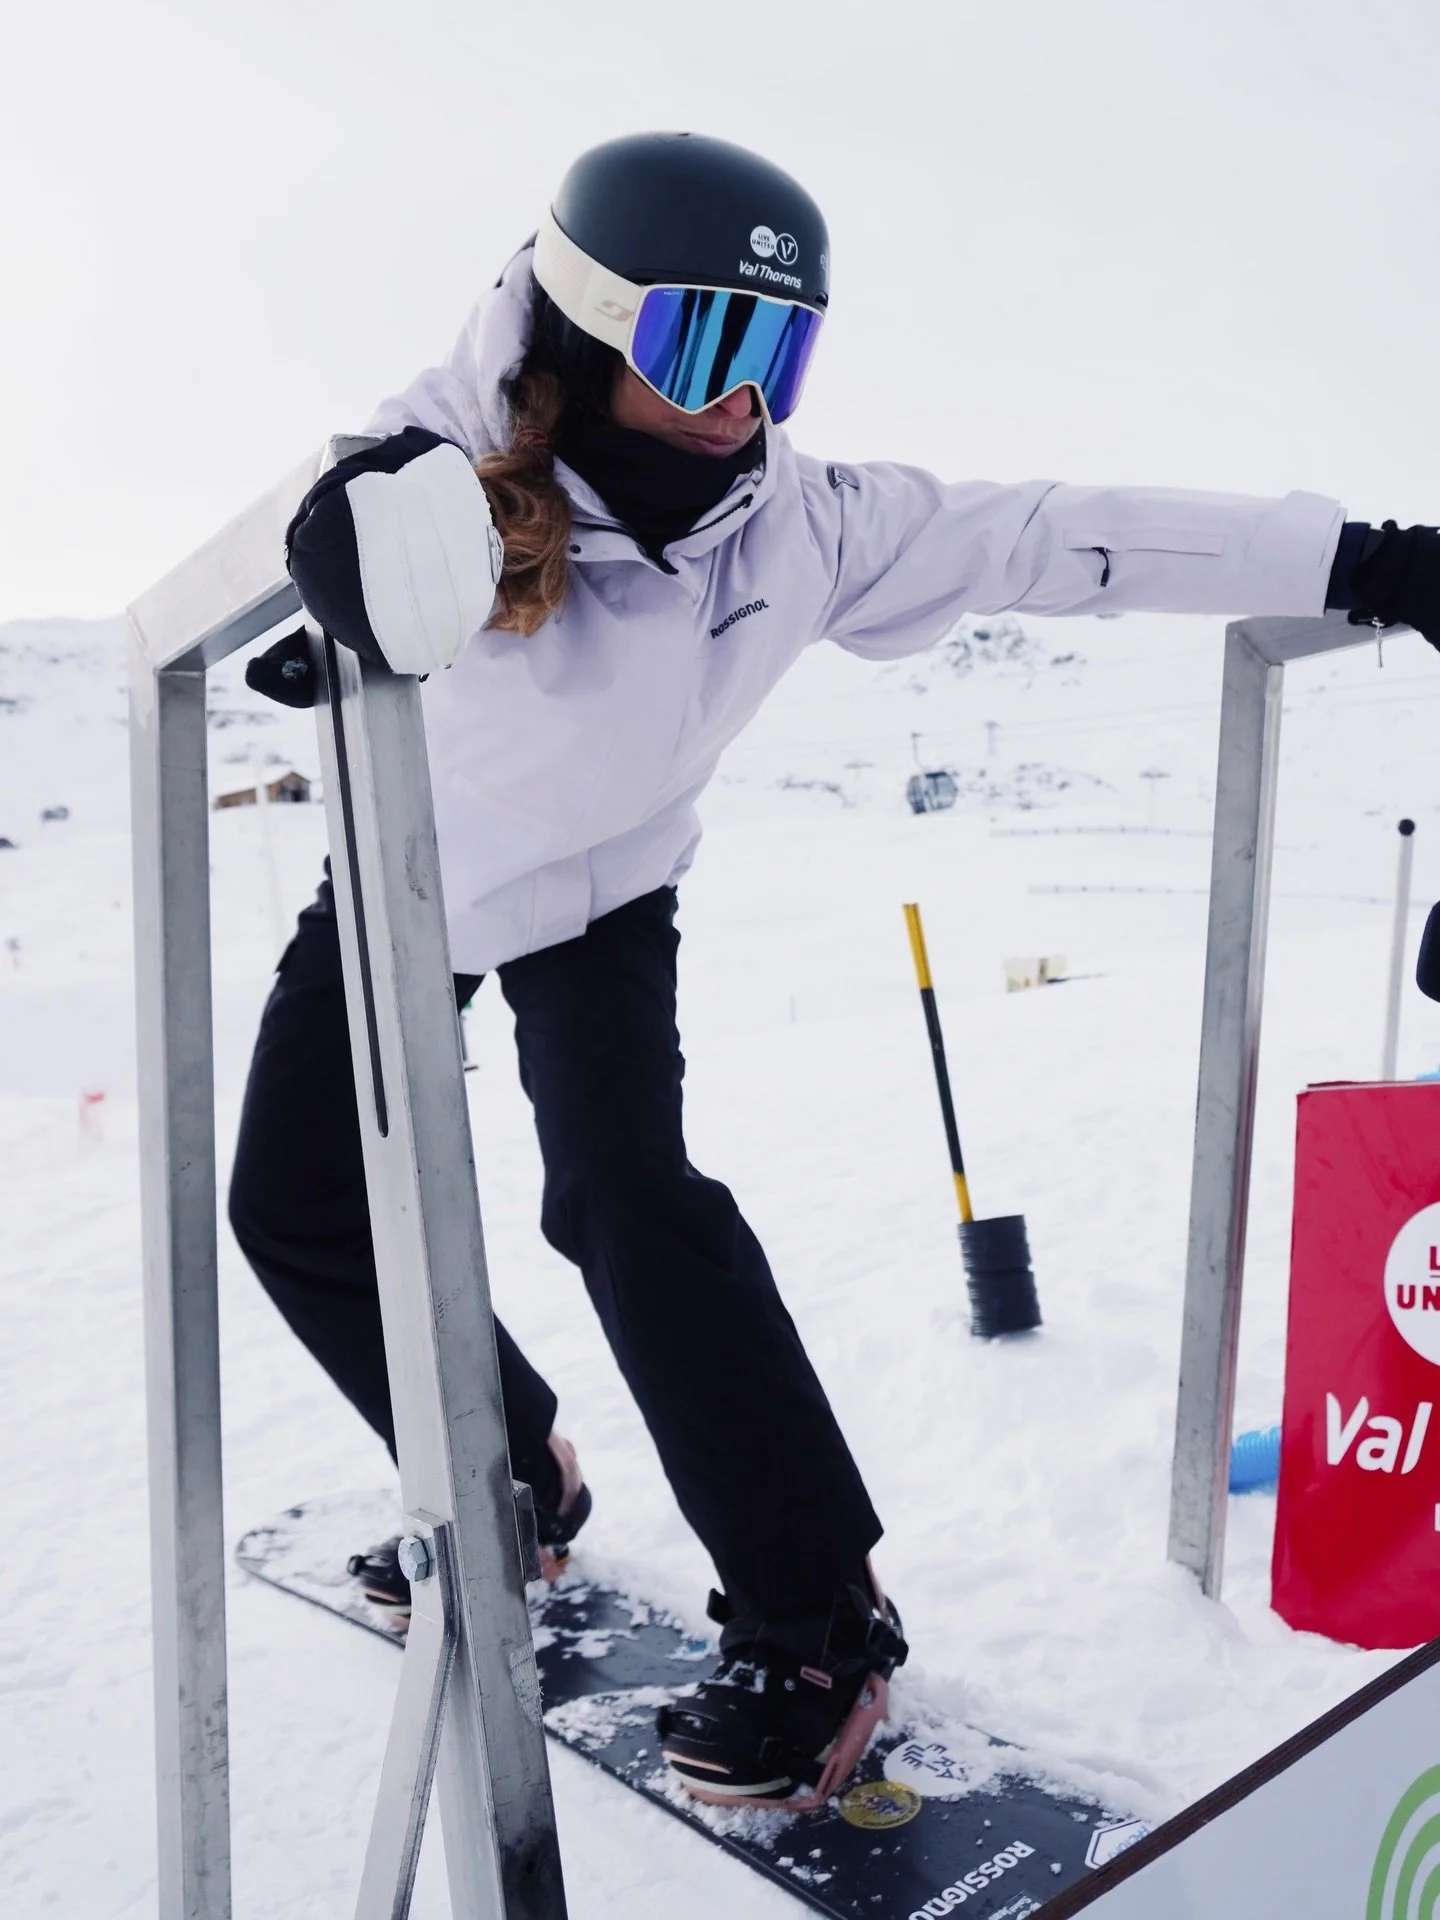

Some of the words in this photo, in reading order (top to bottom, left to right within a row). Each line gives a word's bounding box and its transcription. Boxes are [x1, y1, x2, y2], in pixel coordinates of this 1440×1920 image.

[751, 239, 775, 250] UNITED
[739, 260, 759, 276] Val
[759, 264, 802, 289] Thorens
[710, 598, 769, 639] ROSSIGNOL
[1325, 1391, 1433, 1475] Val
